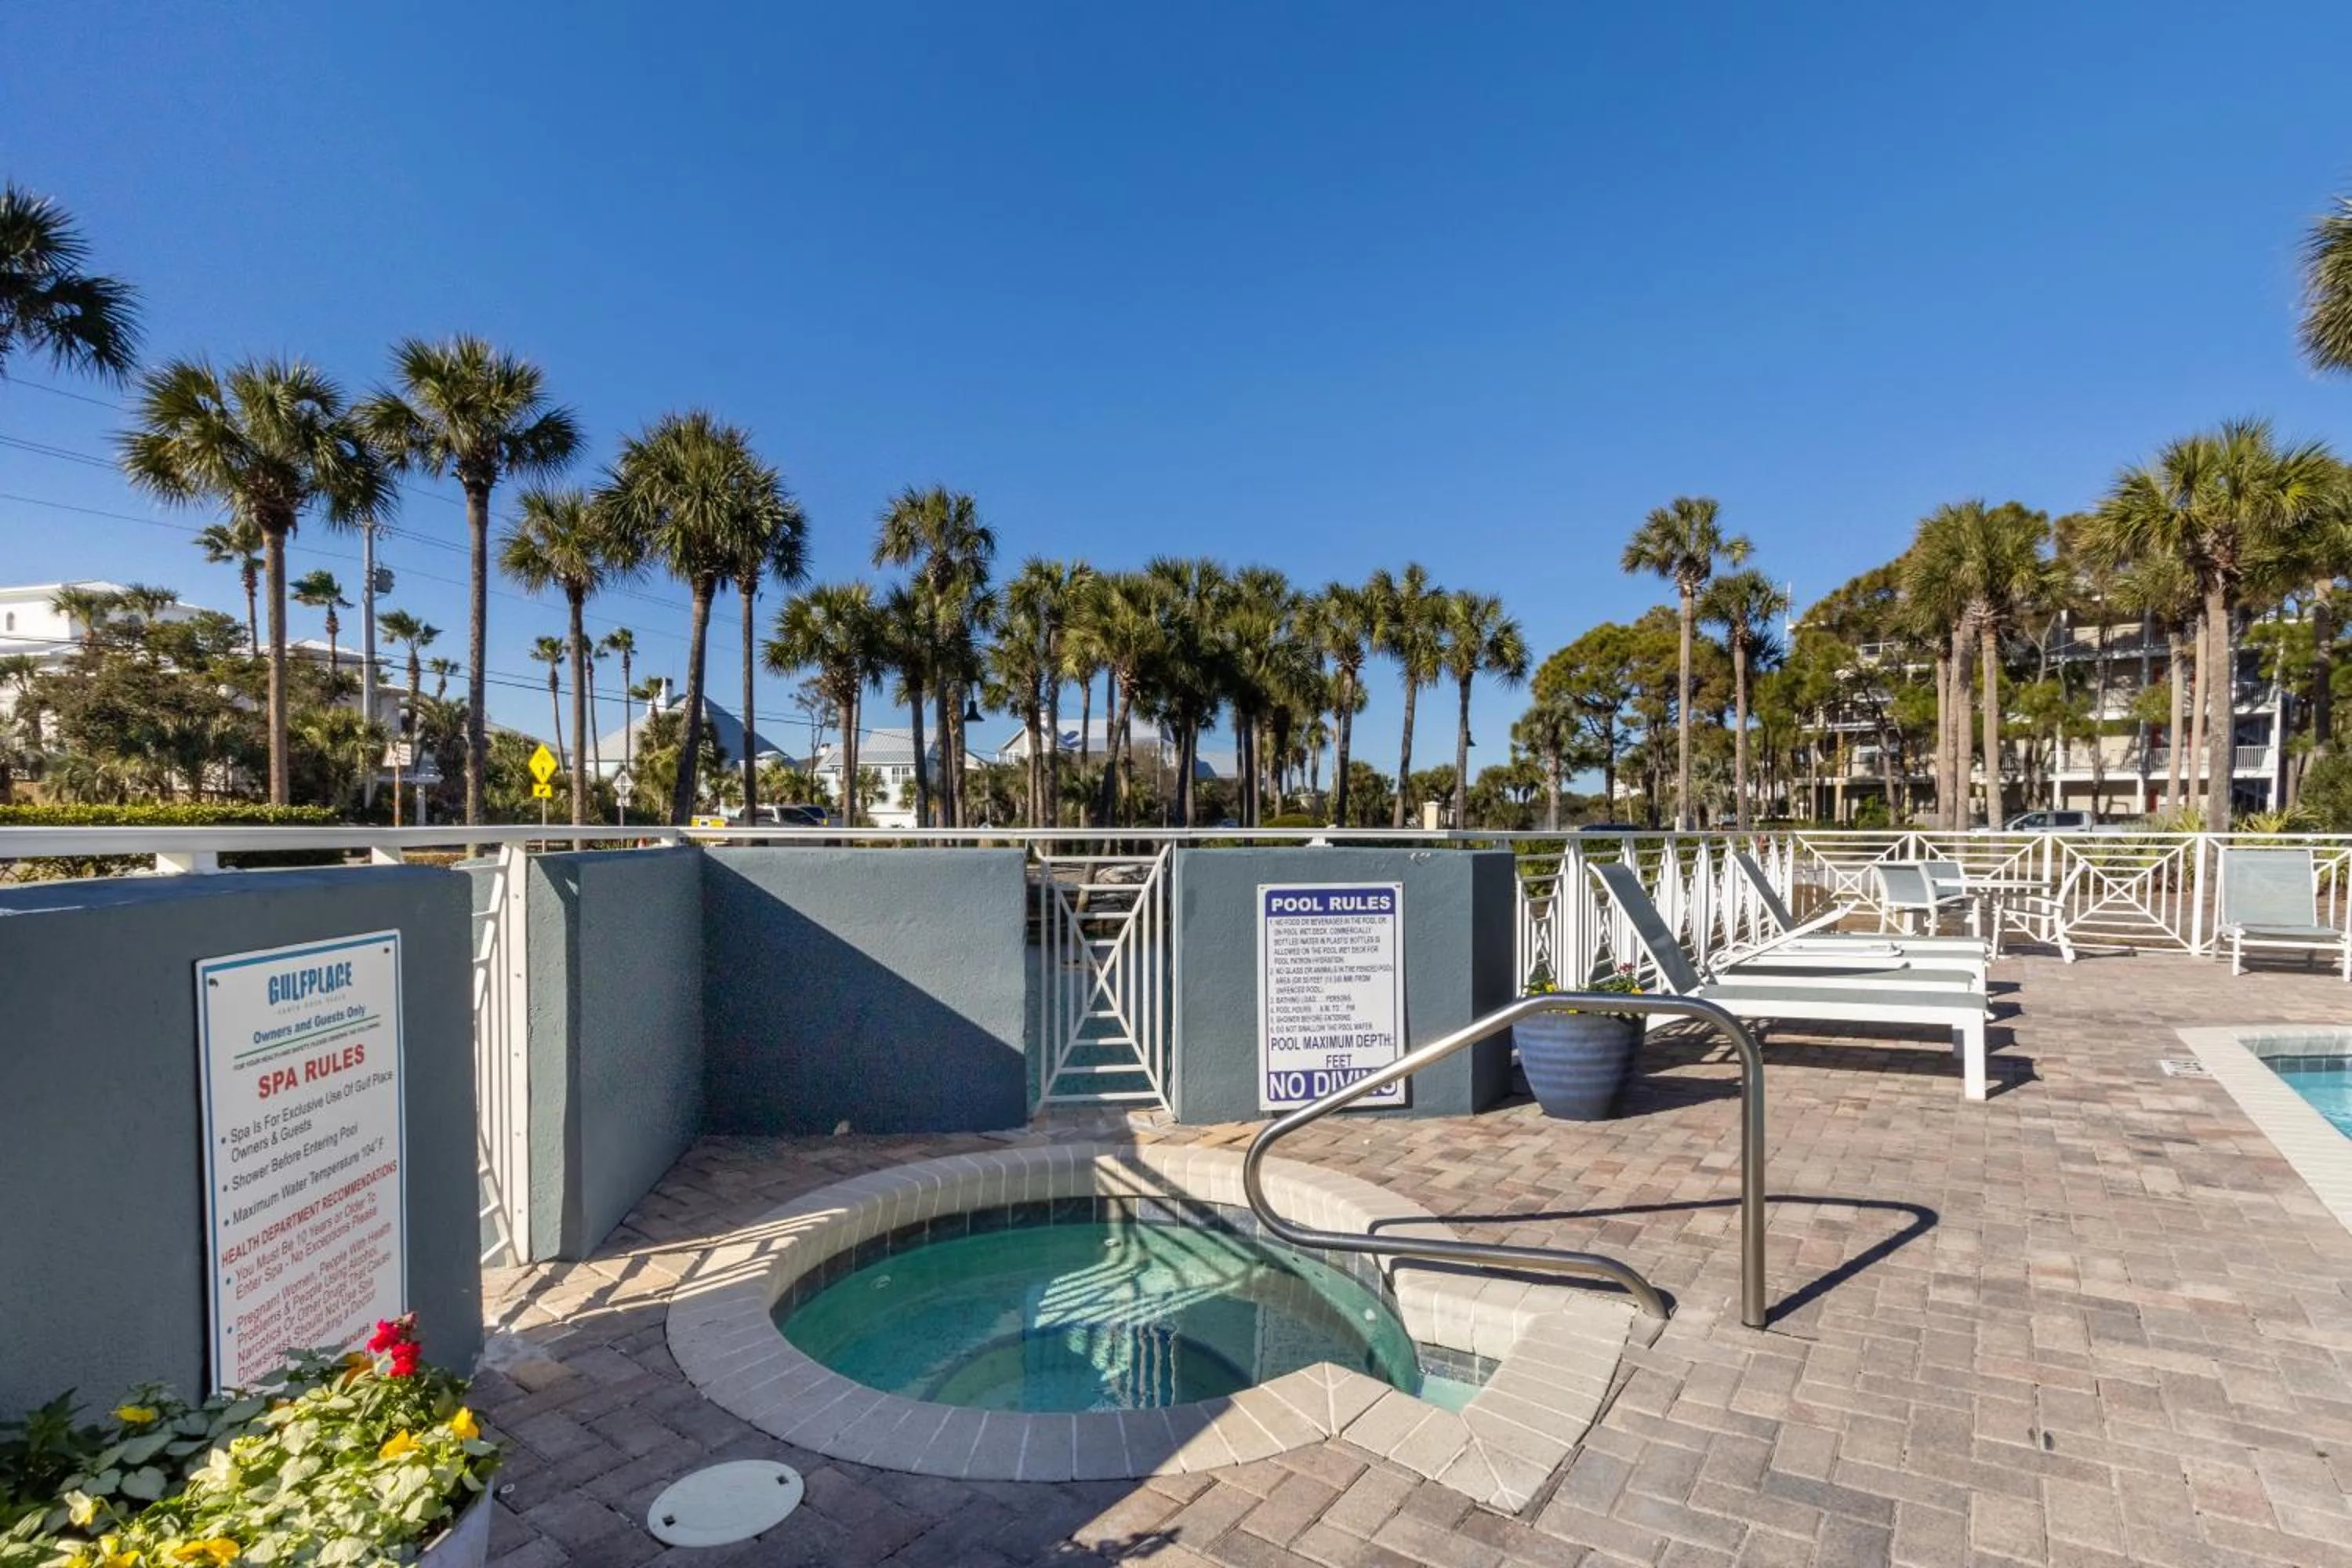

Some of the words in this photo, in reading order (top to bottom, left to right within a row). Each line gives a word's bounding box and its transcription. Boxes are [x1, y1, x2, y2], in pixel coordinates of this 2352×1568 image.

[1270, 897, 1323, 912] POOL
[1329, 895, 1392, 911] RULES
[252, 1025, 292, 1044] Owners
[294, 1017, 313, 1033] and
[314, 1010, 346, 1027] Guests
[347, 1003, 365, 1018] Only
[1271, 1036, 1301, 1051] POOL
[1302, 1034, 1353, 1050] MAXIMUM
[258, 1066, 298, 1098] SPA
[304, 1044, 365, 1083] RULES
[1269, 1072, 1306, 1099] NO
[1326, 1054, 1352, 1068] FEET
[230, 1127, 250, 1144] Spa
[253, 1120, 262, 1134] Is
[264, 1114, 281, 1130] For
[281, 1096, 324, 1122] Exclusive
[325, 1091, 343, 1105] Use
[343, 1082, 354, 1097] Of
[354, 1076, 372, 1092] Gulf
[372, 1070, 394, 1087] Place
[231, 1137, 269, 1163] Owners
[270, 1131, 278, 1145] &
[281, 1119, 313, 1141] Guests
[232, 1164, 269, 1191] Shower
[271, 1149, 302, 1173] Before
[303, 1132, 339, 1157] Entering
[340, 1122, 358, 1141] Pool
[232, 1192, 280, 1225] Maximum
[281, 1178, 308, 1200] Water
[309, 1152, 360, 1185] Temperature
[222, 1233, 260, 1269] HEALTH
[261, 1200, 321, 1245] DEPARTMENT
[322, 1160, 397, 1209] RECOMMENDATIONS
[235, 1264, 255, 1282] You
[256, 1247, 280, 1271] Must
[281, 1240, 294, 1255] Be
[309, 1217, 332, 1236] Years
[345, 1198, 365, 1218] Older
[367, 1191, 377, 1204] To
[236, 1275, 263, 1301] Enter
[264, 1262, 284, 1283] Spa
[291, 1249, 304, 1265] No
[306, 1221, 350, 1256] Exceptions
[352, 1205, 377, 1229] Please
[237, 1291, 280, 1328] Pregnant
[319, 1250, 347, 1276] People
[238, 1308, 281, 1348] Problems
[238, 1326, 282, 1365] Narcotics
